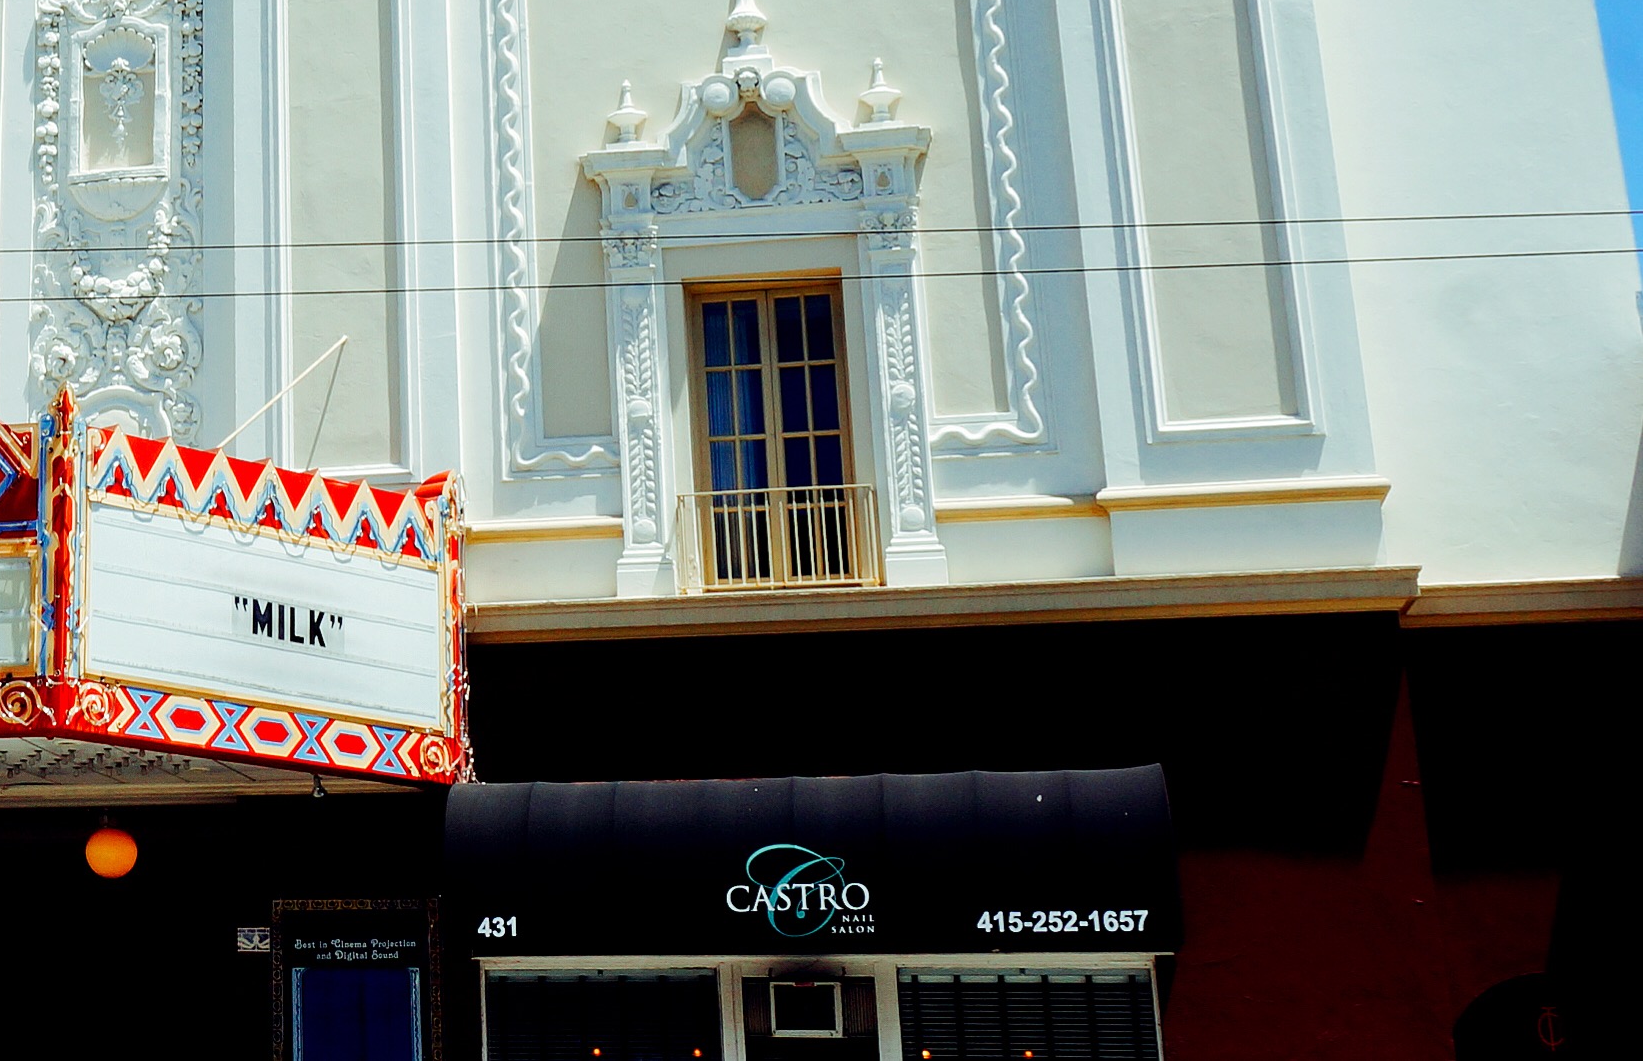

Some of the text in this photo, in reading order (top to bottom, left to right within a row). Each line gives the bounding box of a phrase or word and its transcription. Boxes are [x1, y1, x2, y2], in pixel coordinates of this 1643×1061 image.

[234, 595, 343, 648] "MILK"
[726, 882, 870, 912] CASTRO
[477, 916, 517, 938] 431
[842, 914, 875, 923] NAIL
[976, 910, 1149, 933] 415-252-1657
[831, 925, 875, 934] SALON
[294, 938, 416, 950] Best in Cinema Projection
[316, 950, 399, 961] and Digital Sound
